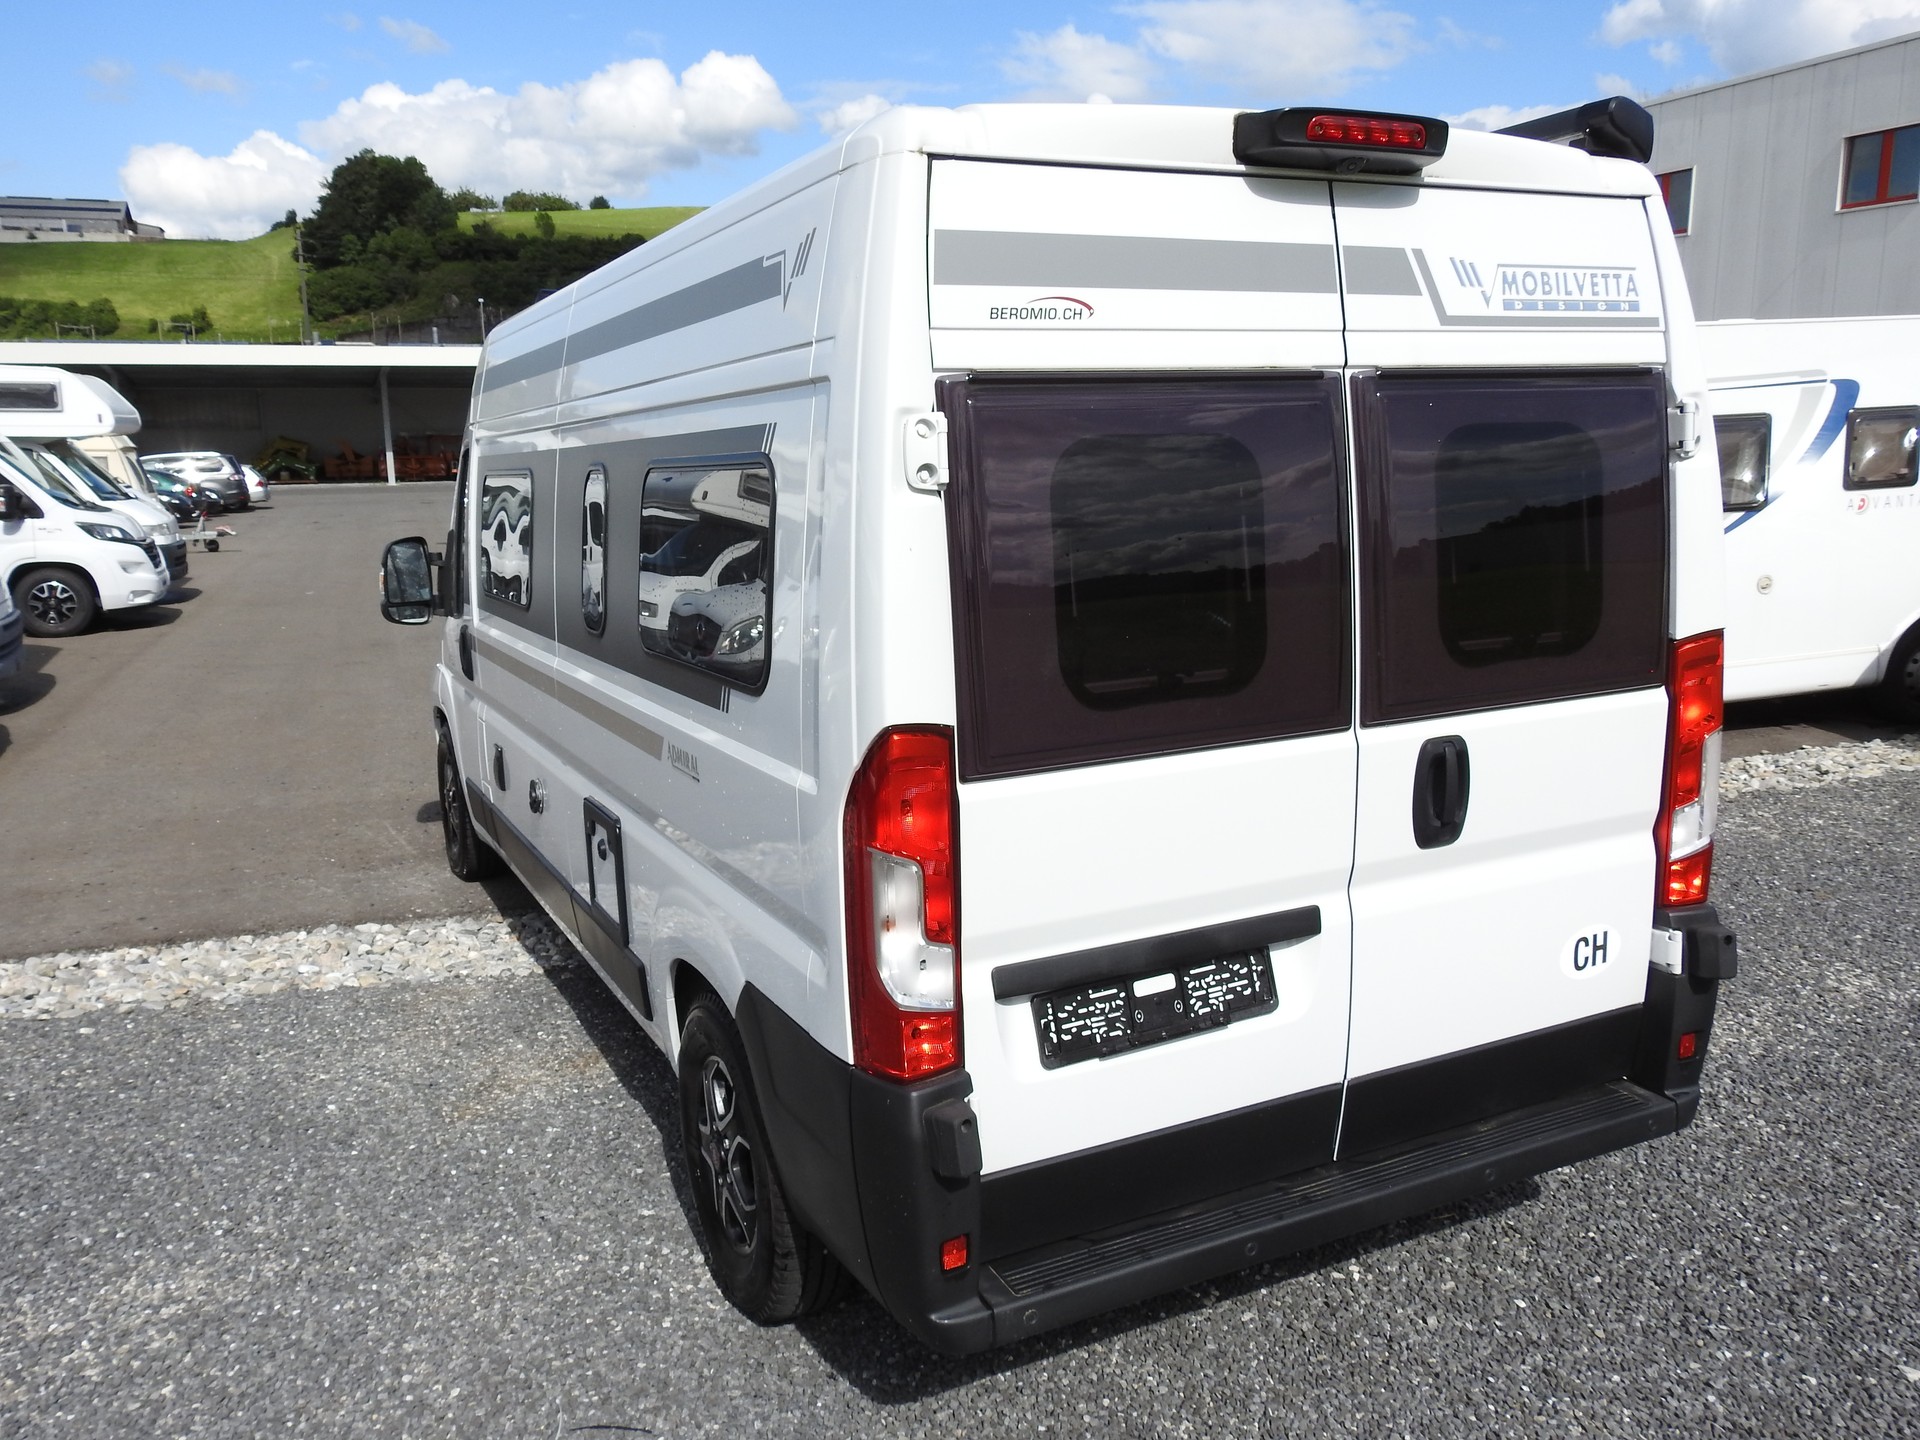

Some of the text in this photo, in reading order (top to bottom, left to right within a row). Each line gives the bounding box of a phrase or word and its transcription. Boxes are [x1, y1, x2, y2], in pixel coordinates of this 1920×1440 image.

[1502, 270, 1639, 297] MOBILVETTA
[989, 307, 1083, 320] BEROMIO.CH
[1514, 301, 1630, 311] DESIGN
[1846, 493, 1920, 515] ADVANT
[667, 741, 699, 777] ADMIRAL
[1573, 931, 1608, 971] CH
